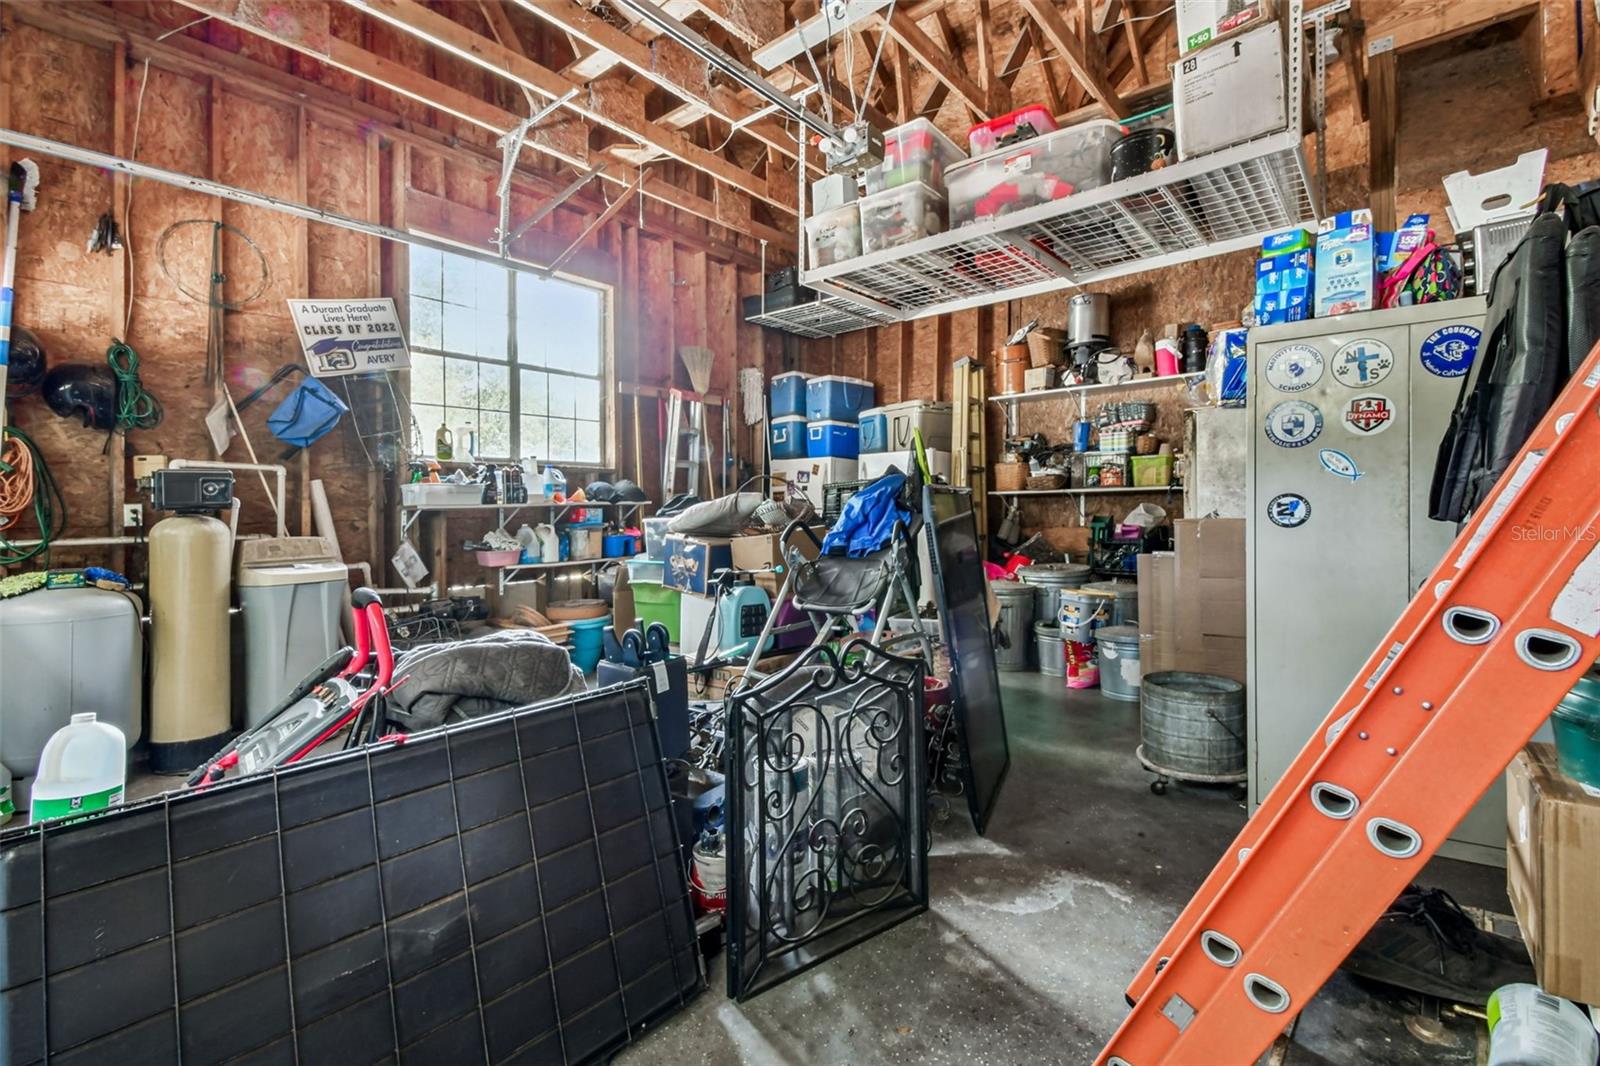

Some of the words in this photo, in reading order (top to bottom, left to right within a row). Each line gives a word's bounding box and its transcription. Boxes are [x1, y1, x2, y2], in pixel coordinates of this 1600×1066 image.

[1184, 59, 1196, 72] 28
[302, 305, 309, 314] A
[311, 305, 343, 314] Durant
[345, 304, 387, 313] Graduate
[322, 314, 345, 323] Lives
[347, 313, 371, 322] Here!
[304, 325, 342, 335] CLASS
[348, 324, 361, 334] OF
[367, 322, 396, 333] 2022
[1426, 332, 1441, 344] THE
[1442, 326, 1480, 339] COUGARS
[367, 354, 395, 364] AVERY
[1268, 347, 1292, 371] NATIVITY
[1294, 344, 1322, 366] CATHOLIC
[1279, 381, 1311, 391] SCHOOL
[1348, 411, 1389, 420] DYNAMO
